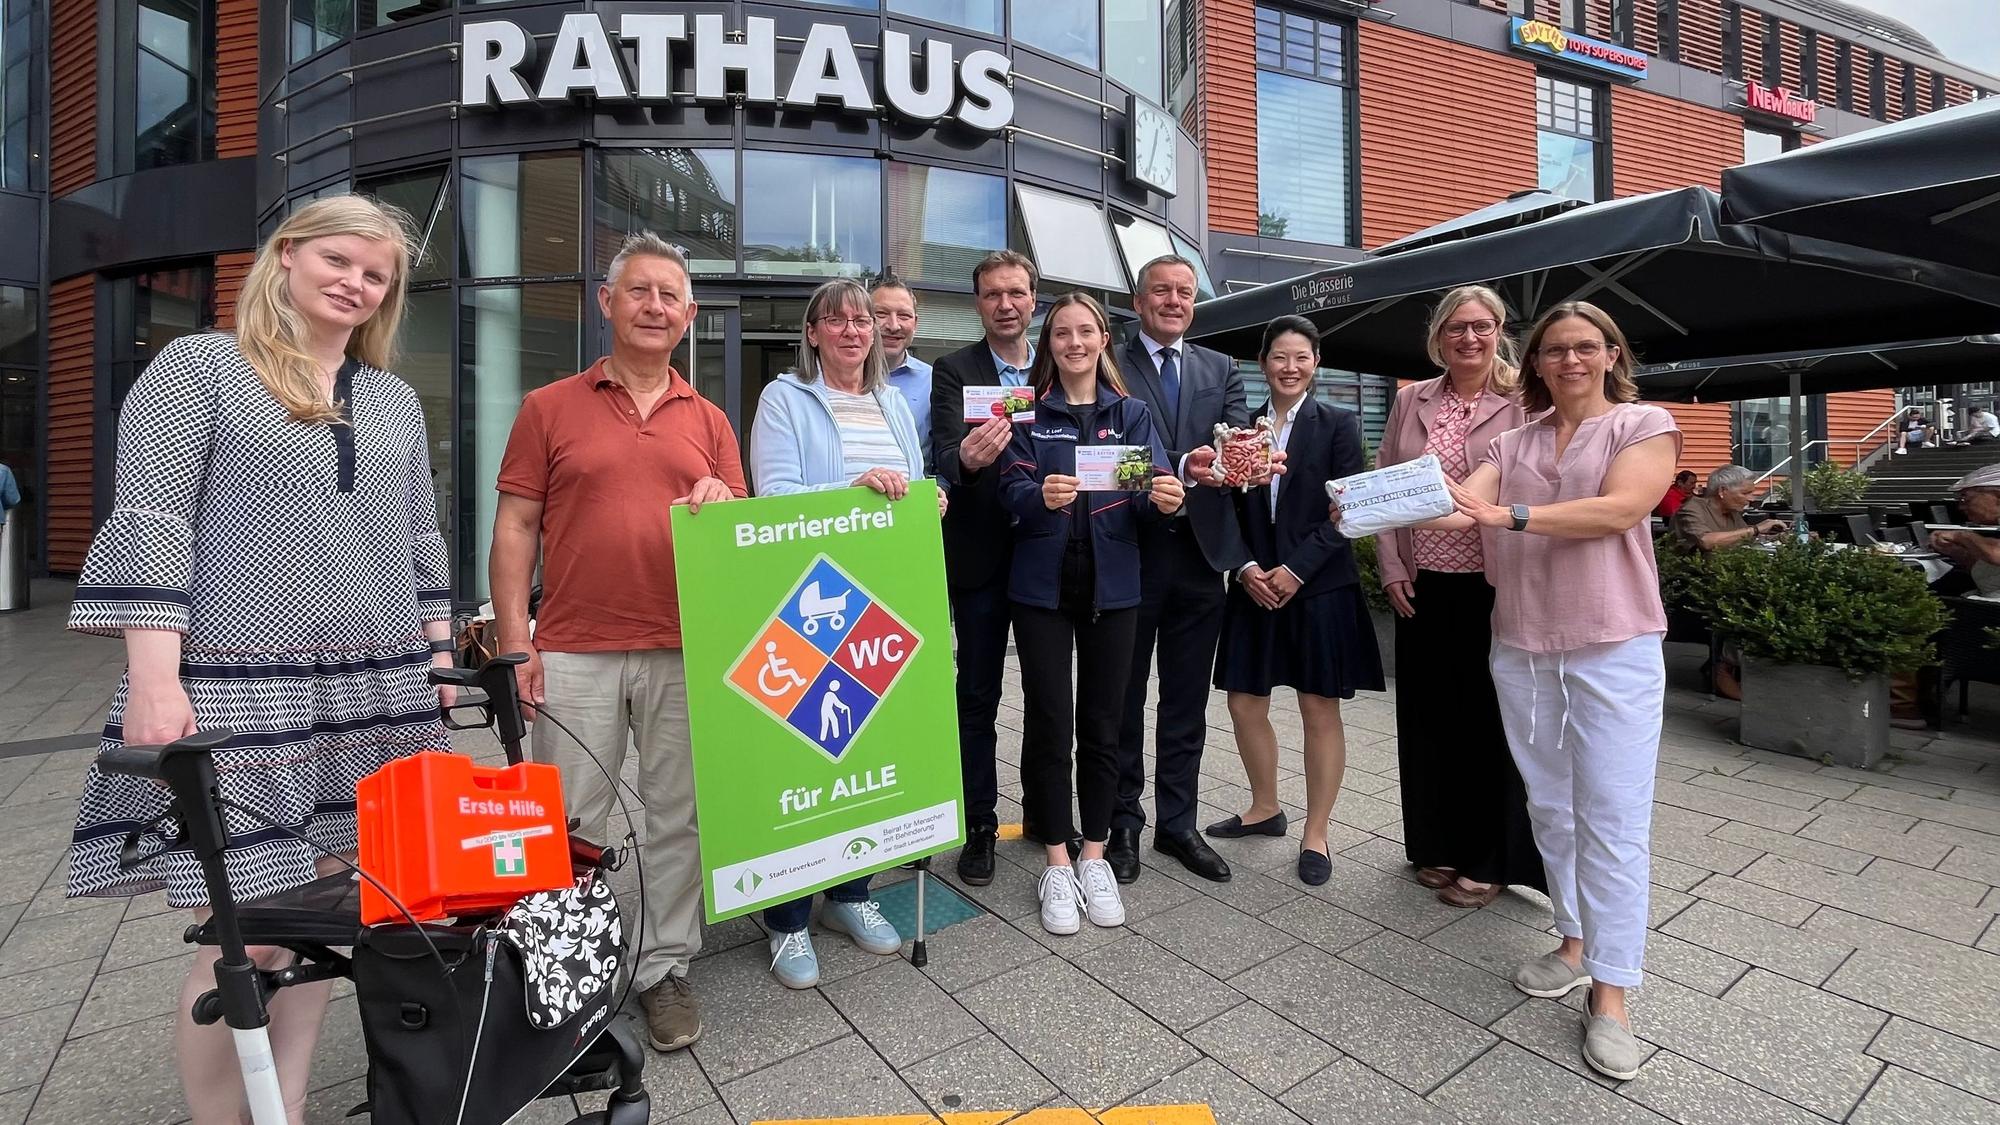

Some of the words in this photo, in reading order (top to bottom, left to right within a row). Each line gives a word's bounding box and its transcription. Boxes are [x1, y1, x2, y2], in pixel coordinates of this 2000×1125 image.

[1523, 24, 1566, 50] SMYTHS
[1568, 40, 1591, 54] TOYS
[1593, 46, 1648, 70] SUPERSTORES
[461, 13, 1015, 132] RATHAUS
[1291, 284, 1308, 301] Die
[1308, 273, 1354, 296] Brasserie
[1295, 302, 1317, 313] STEAK
[1326, 294, 1352, 306] HOUSE
[735, 503, 895, 548] Barrierefrei
[848, 633, 905, 671] WC
[778, 786, 823, 816] für
[829, 763, 898, 802] ALLE
[458, 796, 506, 816] Erste
[508, 799, 546, 817] Hilfe
[883, 825, 902, 836] Beirat
[903, 822, 912, 831] für
[913, 813, 945, 826] Menschen
[883, 836, 894, 845] mit
[895, 824, 935, 841] Behinderung
[893, 842, 907, 850] Stadt
[907, 834, 935, 846] Leverkusen
[769, 868, 788, 880] Stadt
[789, 856, 827, 874] Leverkusen
